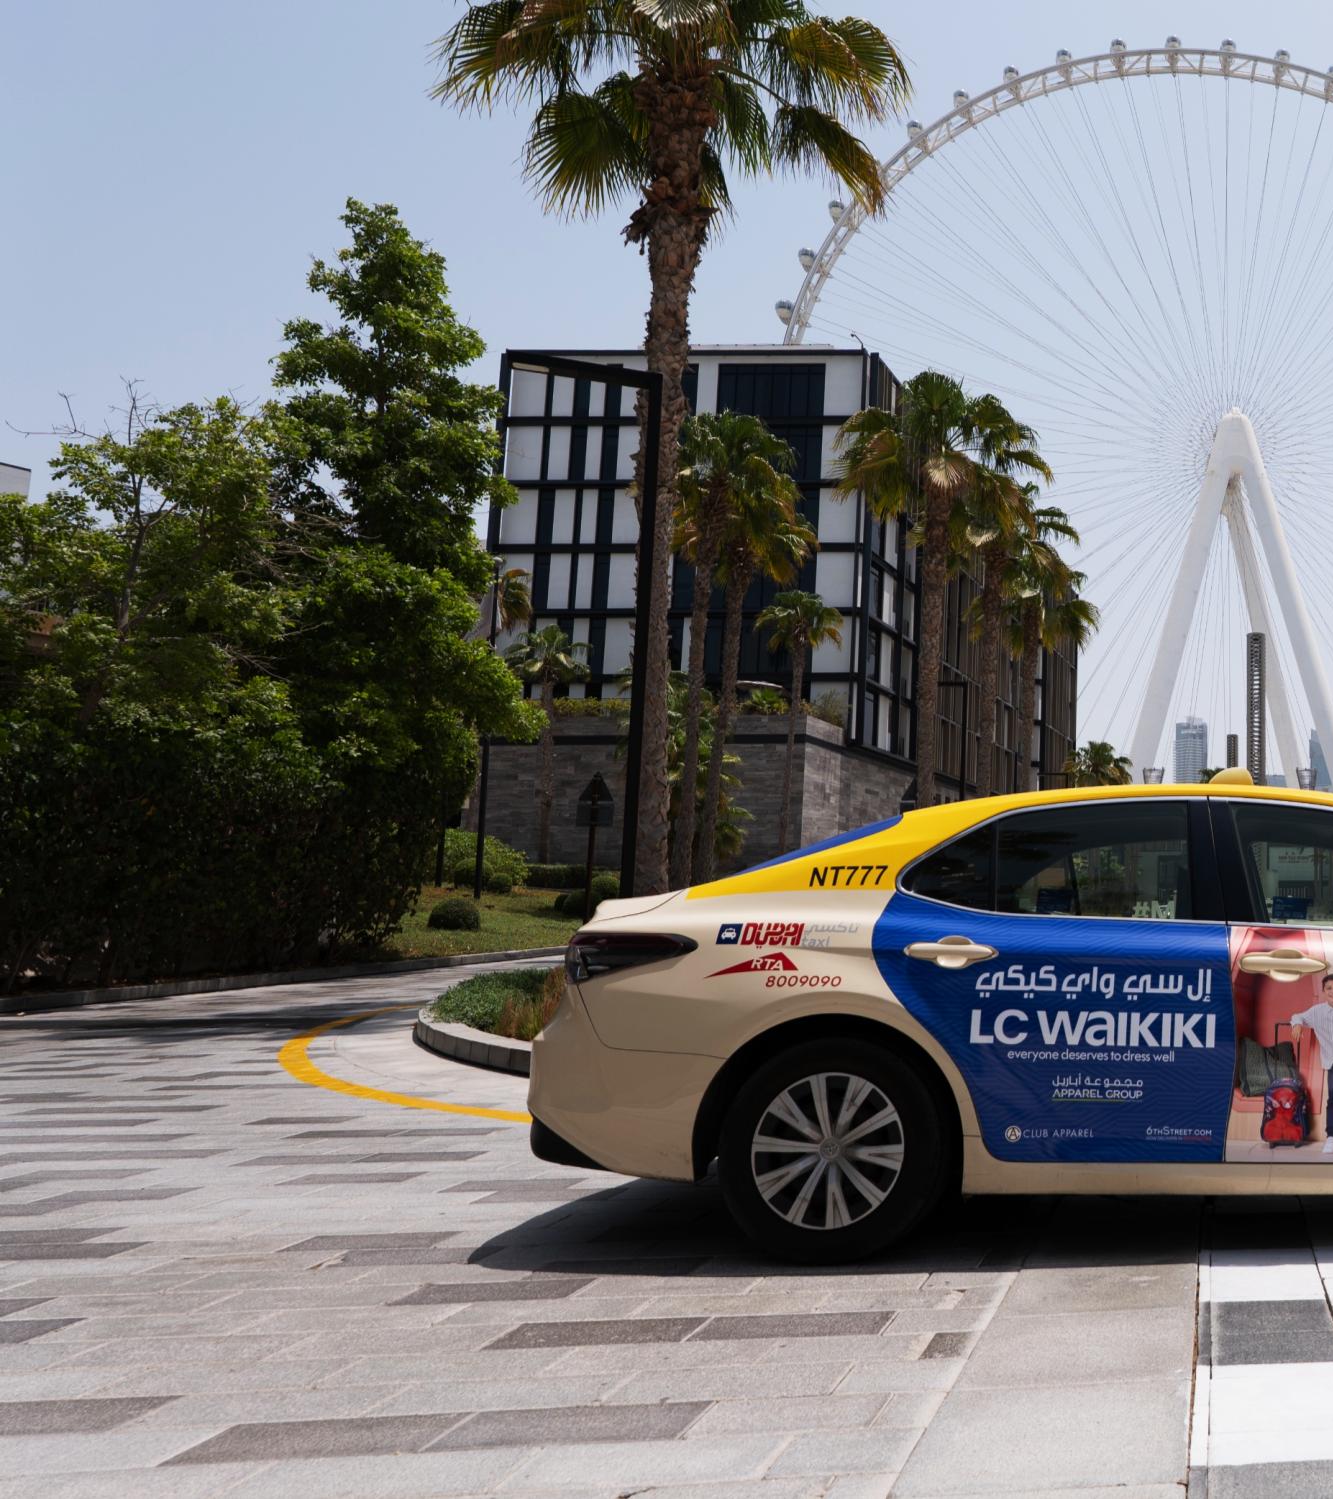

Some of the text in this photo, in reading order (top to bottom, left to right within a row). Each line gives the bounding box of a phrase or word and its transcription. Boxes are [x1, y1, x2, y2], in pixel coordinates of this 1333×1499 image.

[809, 865, 889, 887] NT777
[802, 936, 831, 947] taxi
[751, 958, 784, 970] RTA
[765, 975, 842, 988] 8009090
[975, 964, 1212, 1002] إل سي واي كيكي
[969, 1008, 1029, 1045] LC
[1007, 1049, 1175, 1063] everyone deserves to dress well
[1052, 1088, 1143, 1099] APPAREL GROUP
[1023, 1128, 1094, 1138] CLUB APPAREL
